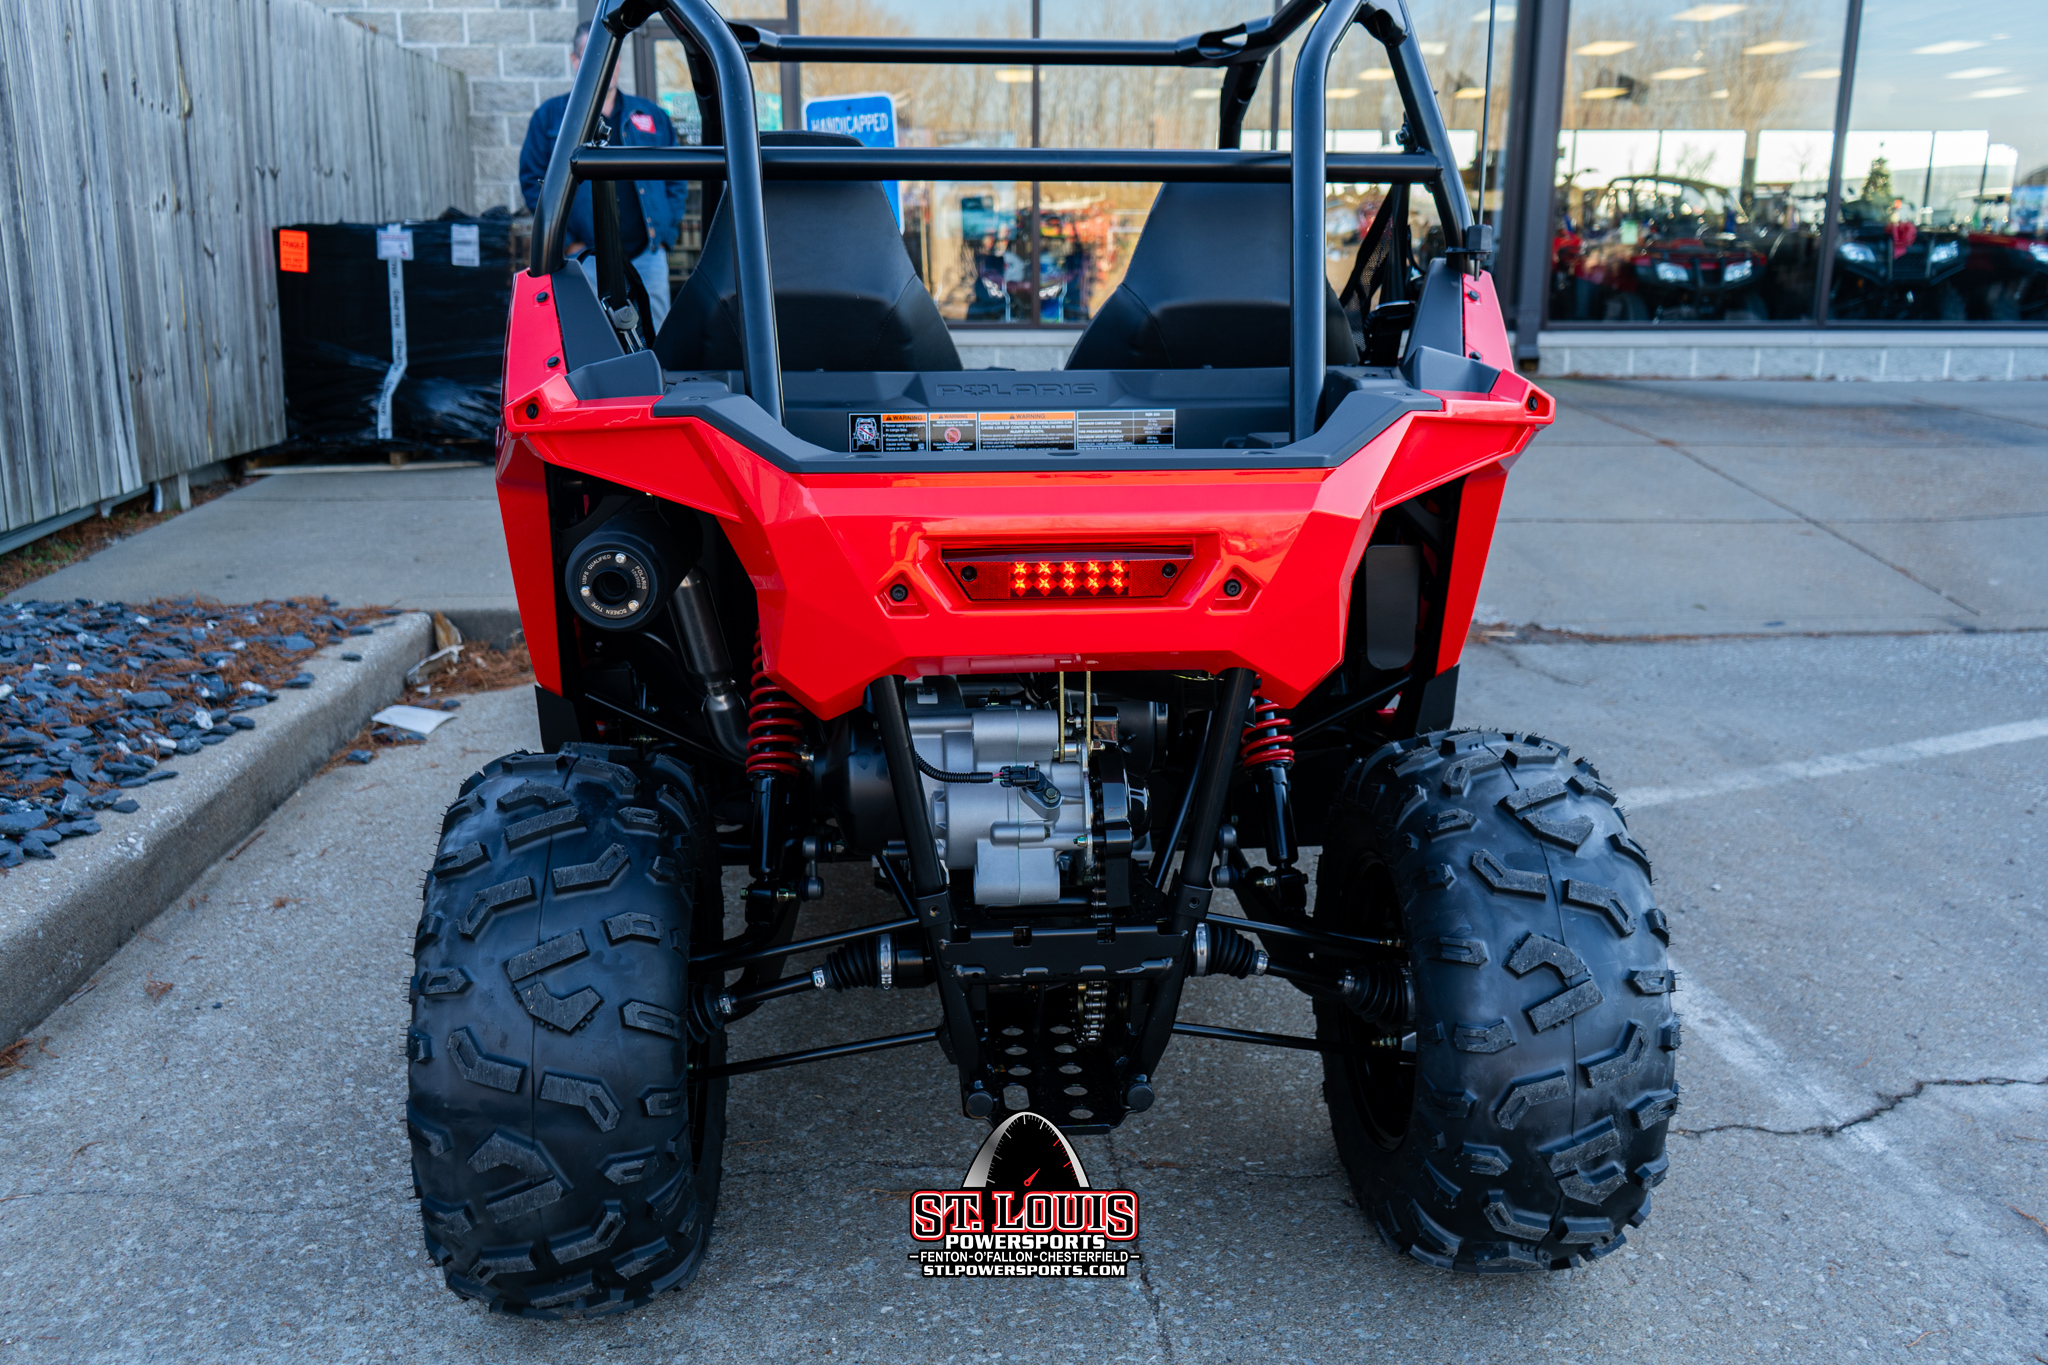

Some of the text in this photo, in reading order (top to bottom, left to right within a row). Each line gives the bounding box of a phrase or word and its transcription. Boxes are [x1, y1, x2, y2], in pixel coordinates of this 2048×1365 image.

[811, 112, 888, 134] HANDICAPPED
[936, 384, 1098, 396] POLARIS
[588, 554, 611, 570] QUALIFIED
[635, 566, 647, 590] POLARIS
[591, 602, 603, 612] TYPE
